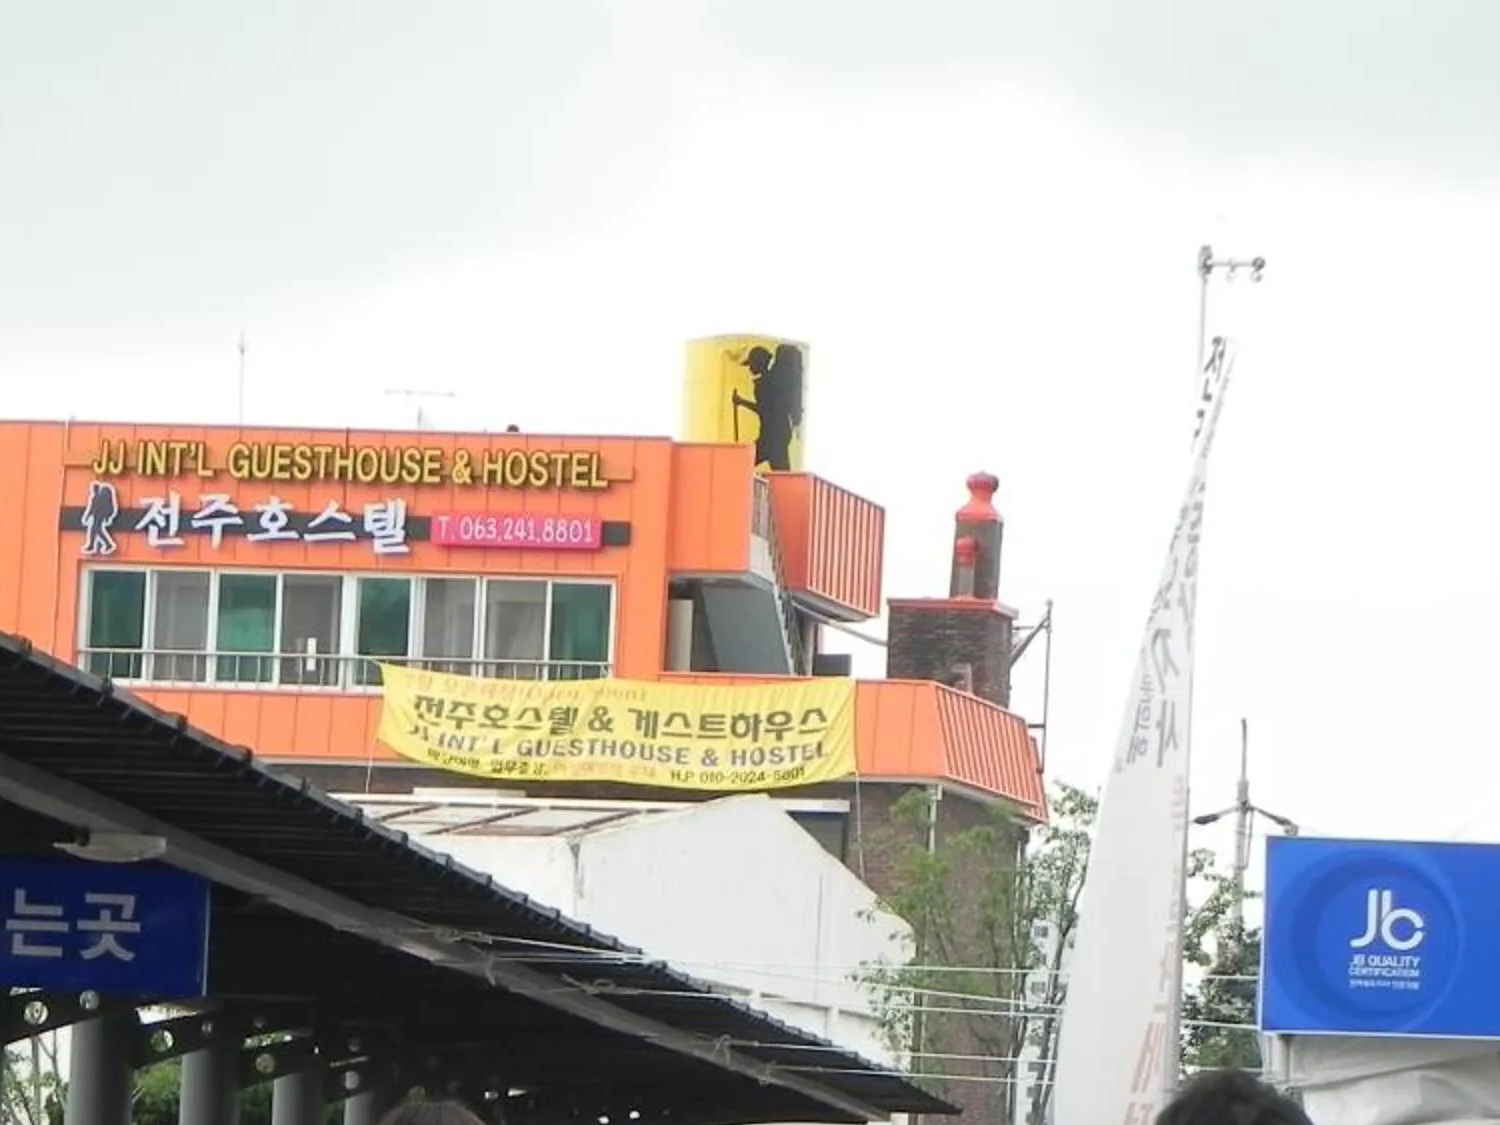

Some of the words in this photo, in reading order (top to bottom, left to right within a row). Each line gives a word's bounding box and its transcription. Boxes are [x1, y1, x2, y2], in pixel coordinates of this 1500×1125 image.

[92, 441, 125, 476] JJ
[137, 442, 213, 477] INT'L
[227, 443, 441, 484] GUESTHOUSE
[452, 452, 472, 485] &
[483, 450, 608, 488] HOSTEL
[134, 492, 411, 555] 전주호스텔
[413, 694, 579, 738] 전주호스텔
[588, 705, 614, 732] &
[628, 705, 828, 743] 게스트하우스
[516, 739, 690, 766] GUESTHOUSE
[700, 746, 720, 767] &
[731, 740, 830, 768] HOSTEL
[1368, 954, 1421, 968] QUALITY
